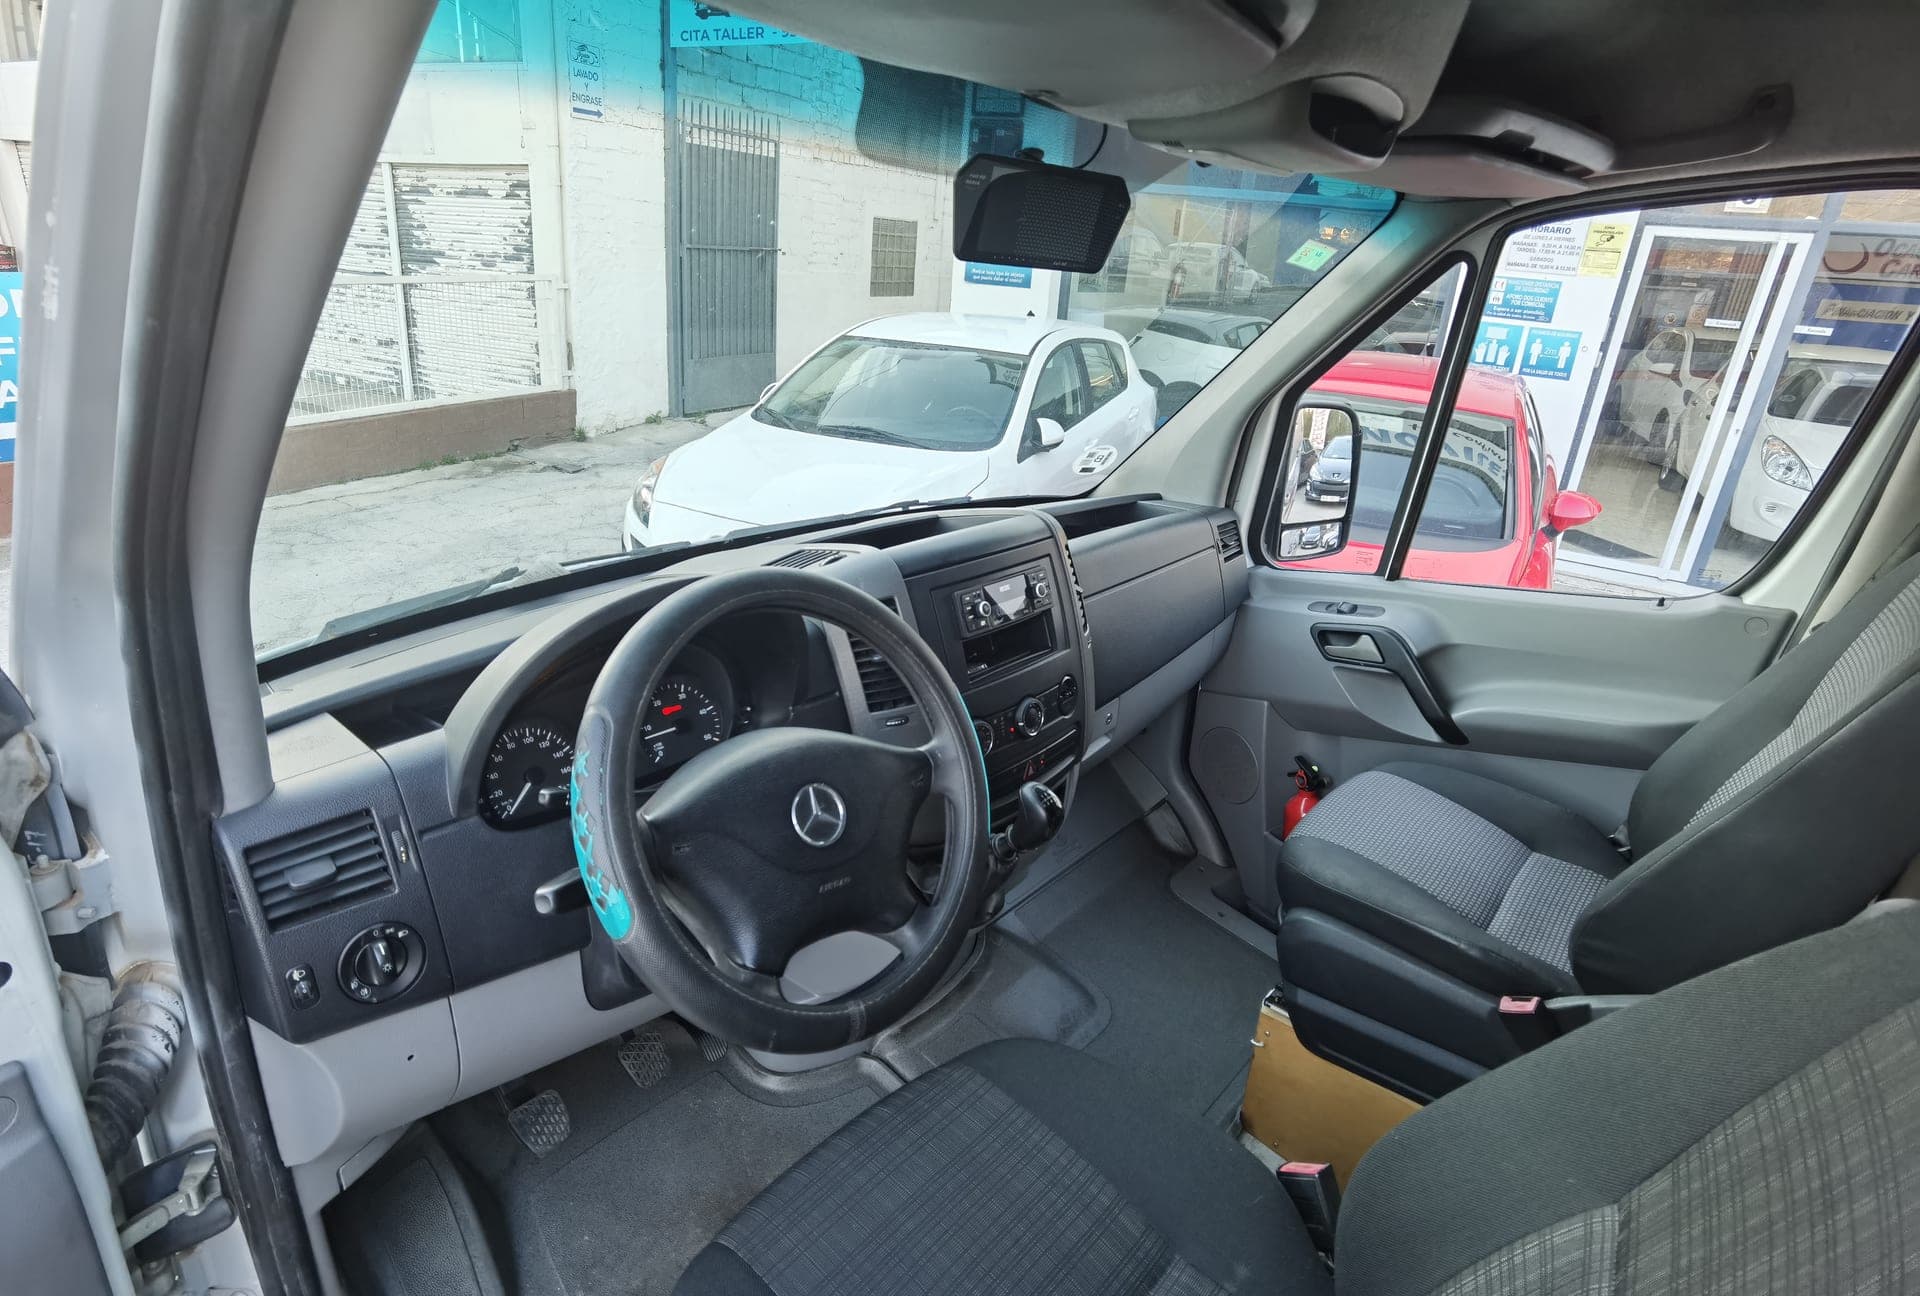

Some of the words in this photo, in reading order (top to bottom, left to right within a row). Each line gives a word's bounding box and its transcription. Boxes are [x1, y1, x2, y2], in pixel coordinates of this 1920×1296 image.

[680, 29, 710, 42] CITA
[713, 26, 765, 41] TALLER
[573, 67, 599, 82] LAVADO
[584, 82, 589, 91] Y
[572, 92, 603, 107] ENGRASE
[653, 699, 662, 707] 20
[644, 724, 652, 732] 10
[523, 736, 535, 745] 100
[507, 742, 516, 750] 80
[539, 741, 550, 749] 120
[495, 755, 503, 763] 60
[553, 751, 564, 759] 140
[560, 766, 572, 775] 160
[490, 772, 499, 780] 40
[494, 789, 503, 798] 20
